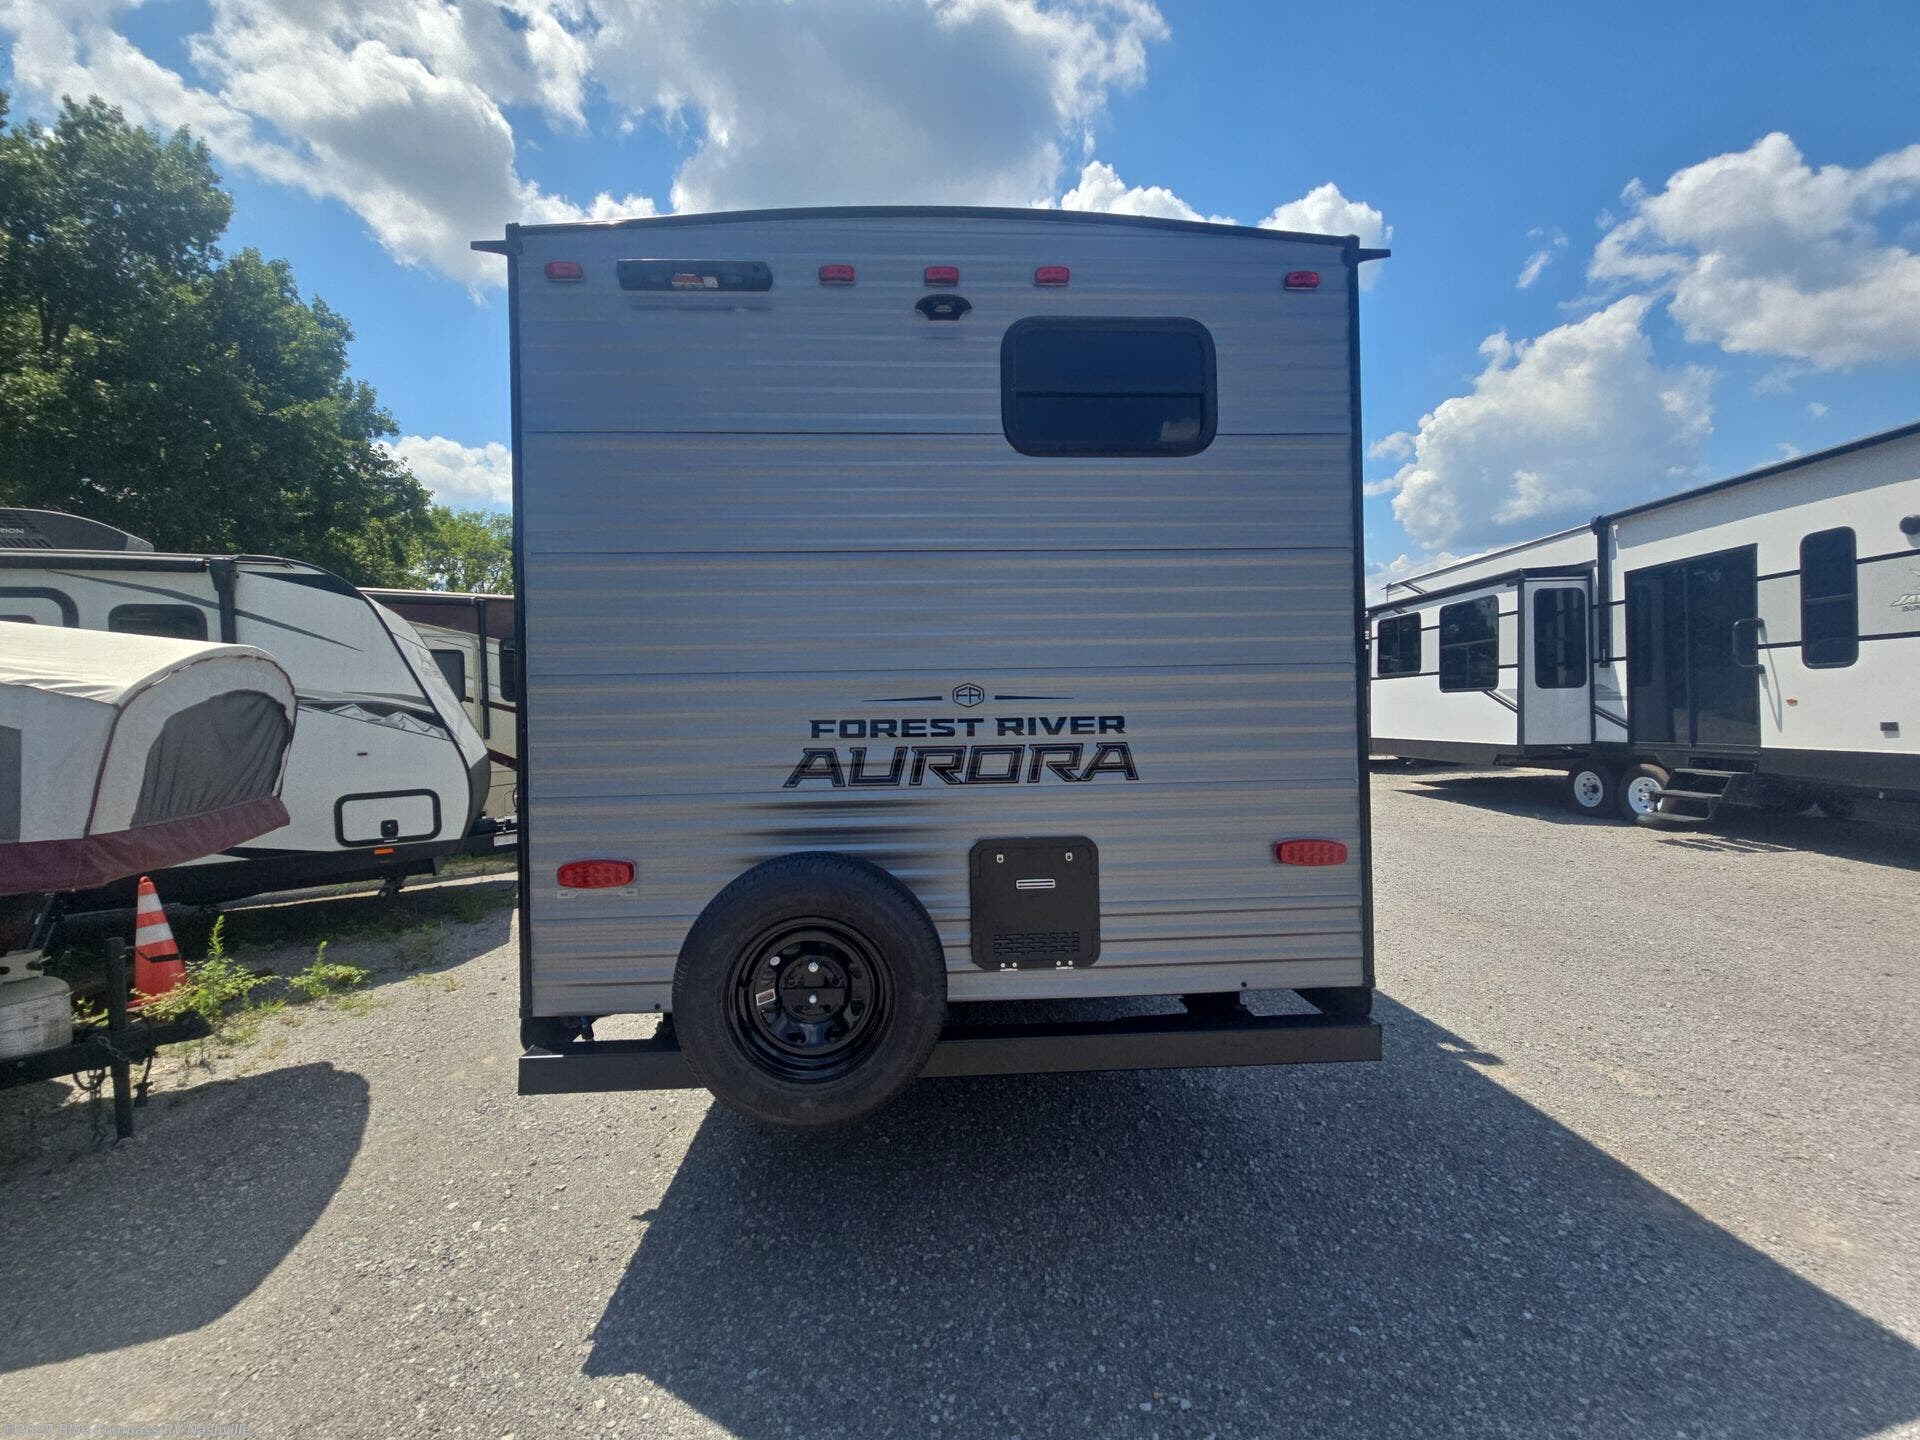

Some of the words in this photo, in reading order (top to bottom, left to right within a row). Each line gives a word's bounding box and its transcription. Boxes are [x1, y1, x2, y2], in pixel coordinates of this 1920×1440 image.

[809, 717, 985, 739] FOREST
[994, 715, 1127, 736] RIVER
[782, 742, 1140, 788] AURORA
